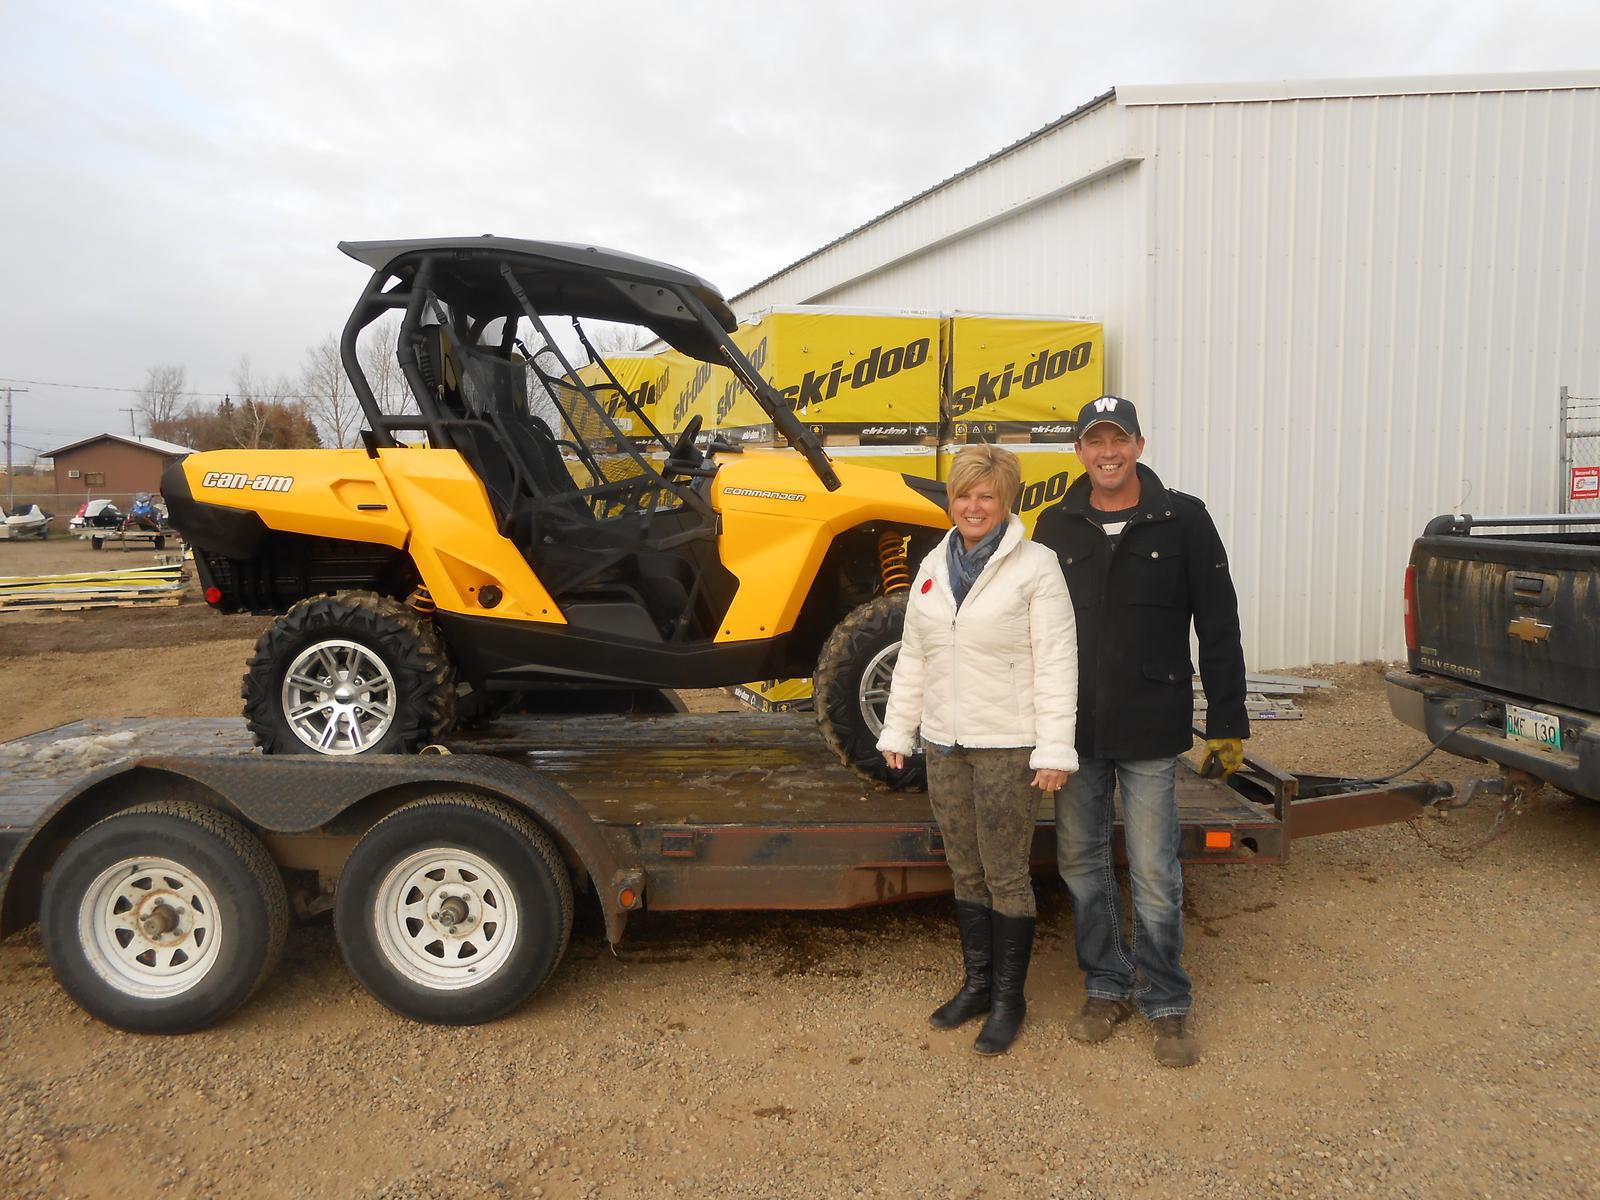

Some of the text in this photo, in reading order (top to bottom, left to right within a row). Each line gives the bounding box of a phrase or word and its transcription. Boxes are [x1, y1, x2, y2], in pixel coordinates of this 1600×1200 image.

[778, 337, 931, 412] ski-doo
[951, 341, 1093, 418] ski-doo
[1093, 397, 1119, 413] W
[202, 472, 294, 492] can-am
[723, 486, 806, 501] COMMANDER
[1534, 722, 1556, 744] 130
